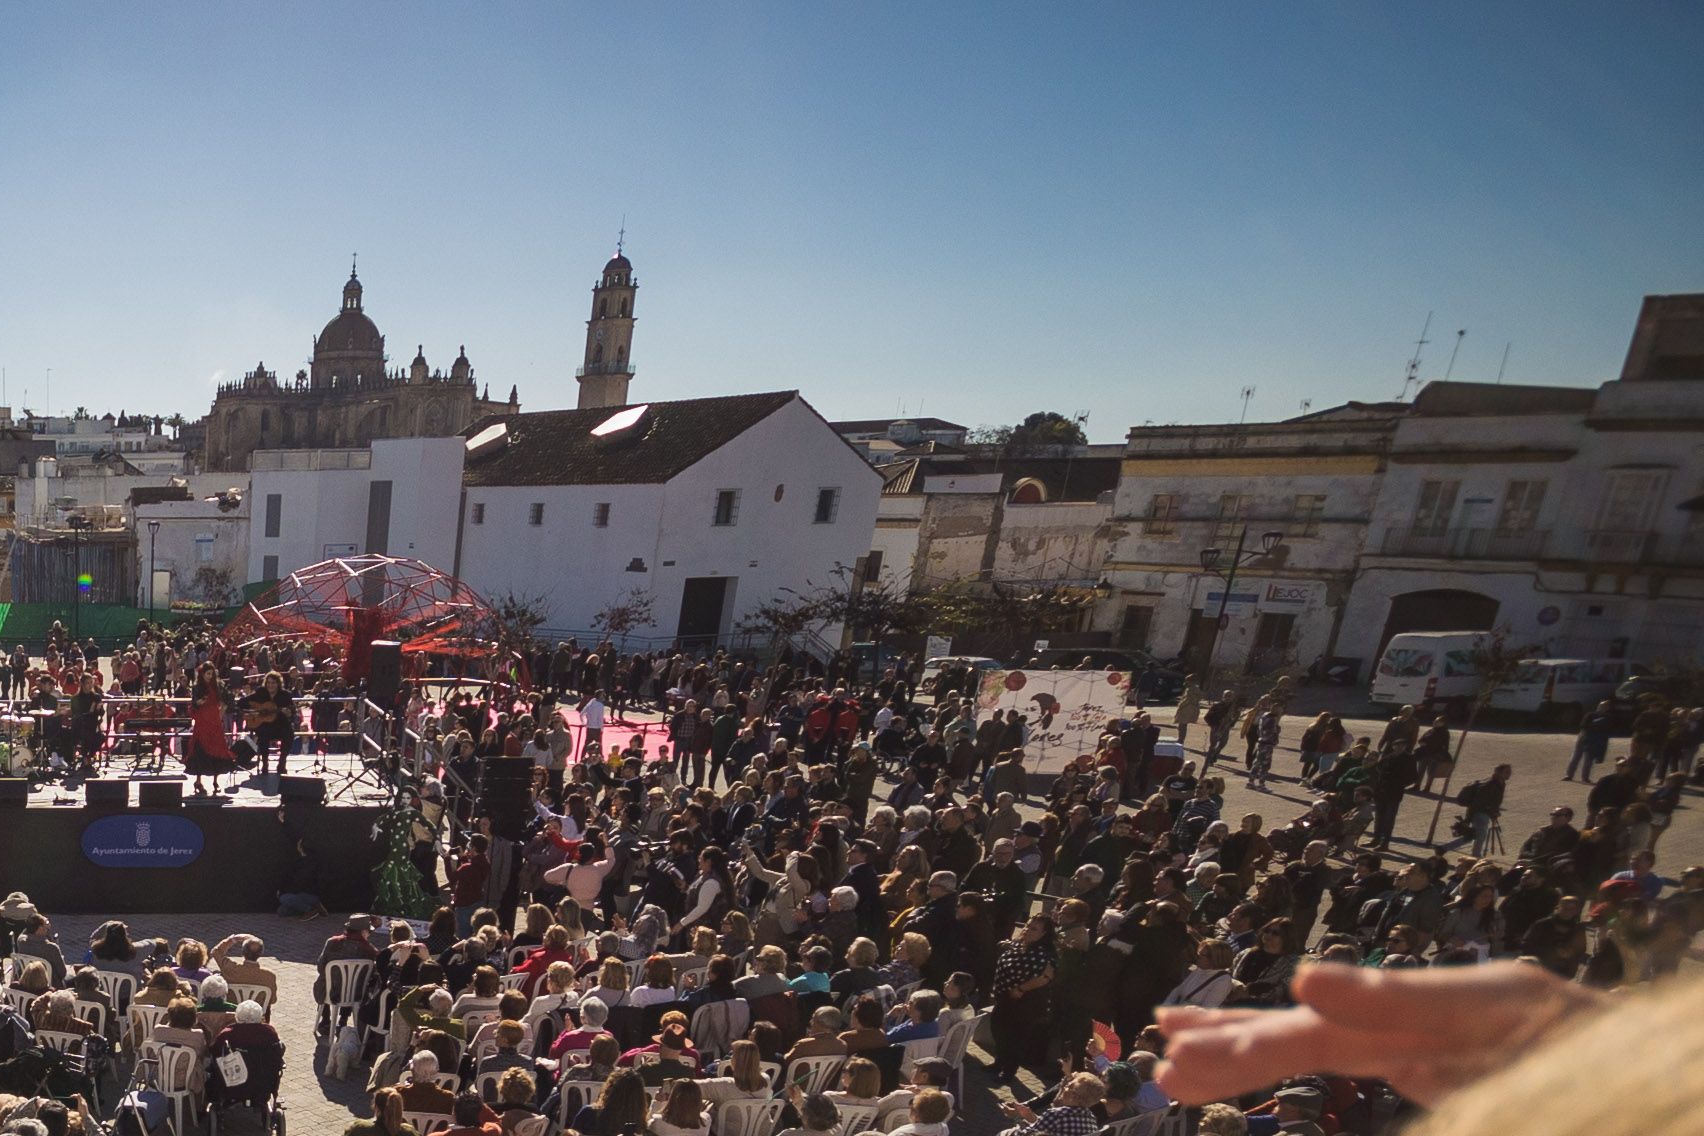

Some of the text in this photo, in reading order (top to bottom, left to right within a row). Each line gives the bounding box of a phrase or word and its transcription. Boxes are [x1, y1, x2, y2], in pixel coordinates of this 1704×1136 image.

[92, 847, 193, 857] Ayuntamiento de Jerez
